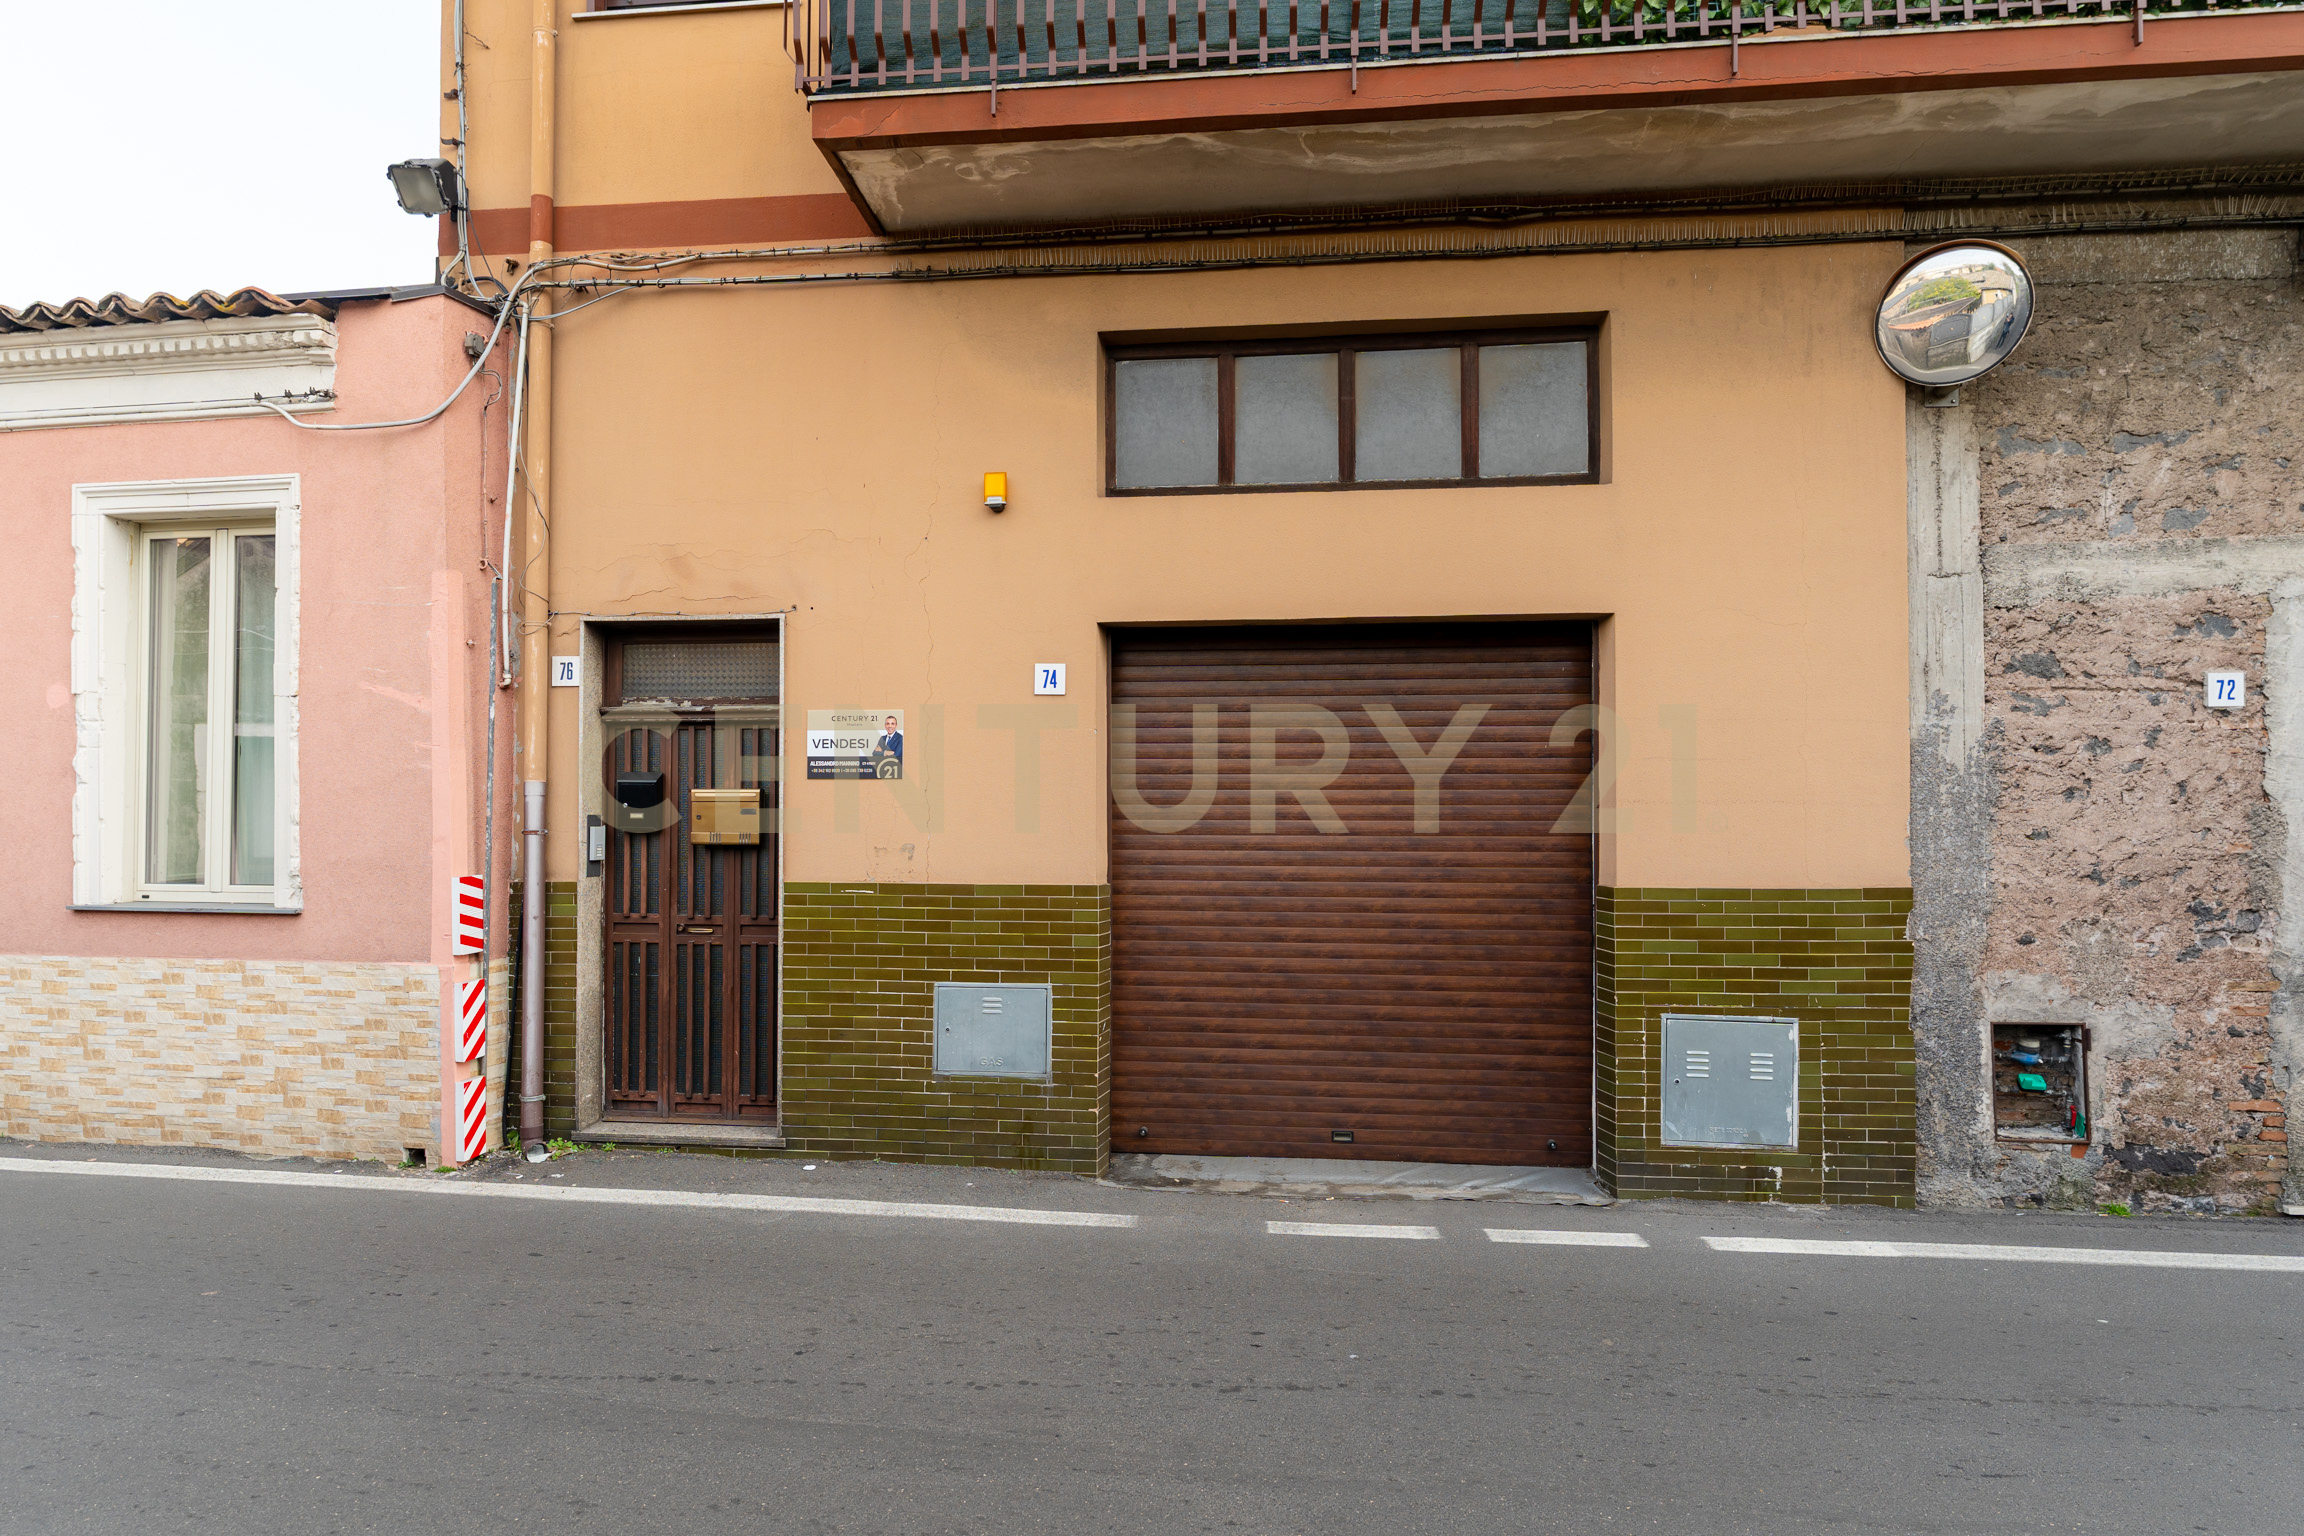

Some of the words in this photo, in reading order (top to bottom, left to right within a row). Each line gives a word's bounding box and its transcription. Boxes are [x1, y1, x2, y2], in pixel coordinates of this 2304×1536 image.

[560, 662, 573, 680] 76
[1043, 669, 1057, 688] 74
[2216, 679, 2235, 700] 72
[812, 738, 869, 749] VENDESI
[979, 1056, 1004, 1067] GAS
